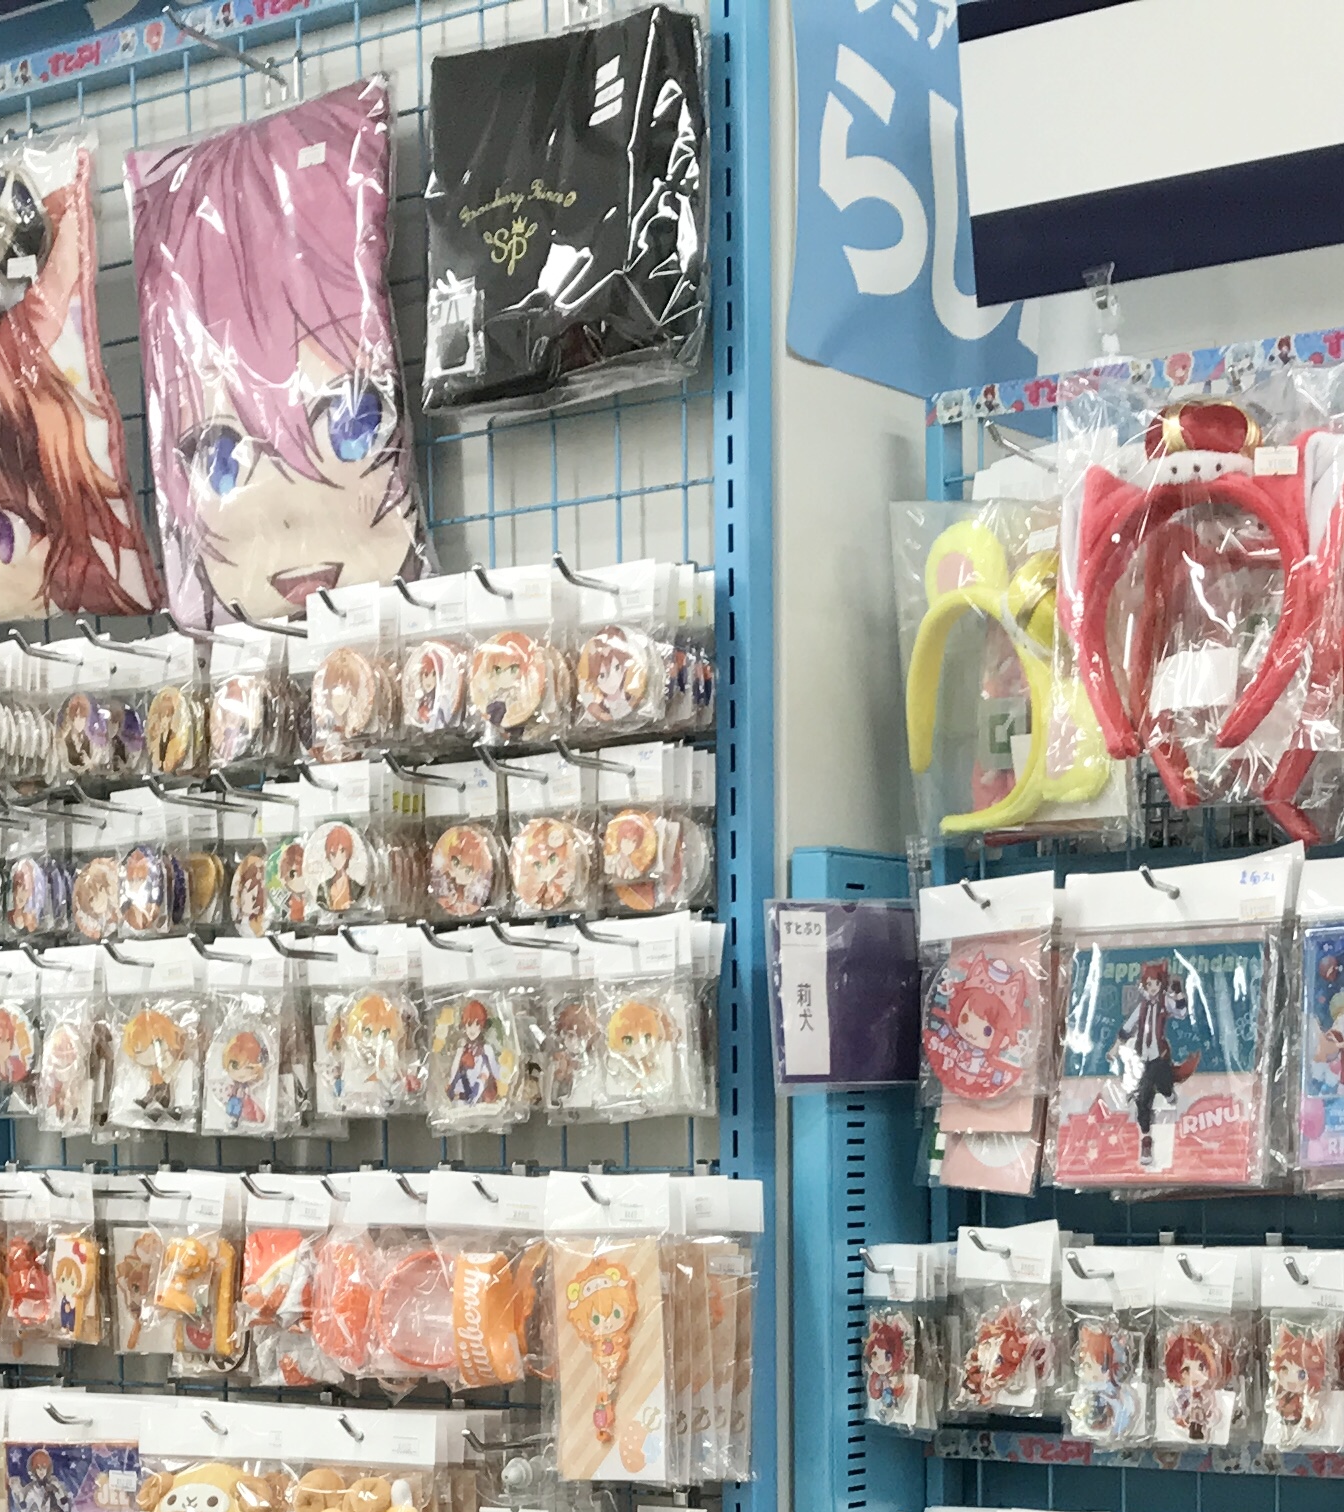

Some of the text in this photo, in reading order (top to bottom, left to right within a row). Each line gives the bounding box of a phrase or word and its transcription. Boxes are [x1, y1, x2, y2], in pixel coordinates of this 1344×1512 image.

[784, 921, 822, 936] すとぷり
[796, 982, 814, 1032] 莉犬
[1182, 1102, 1241, 1134] RINU
